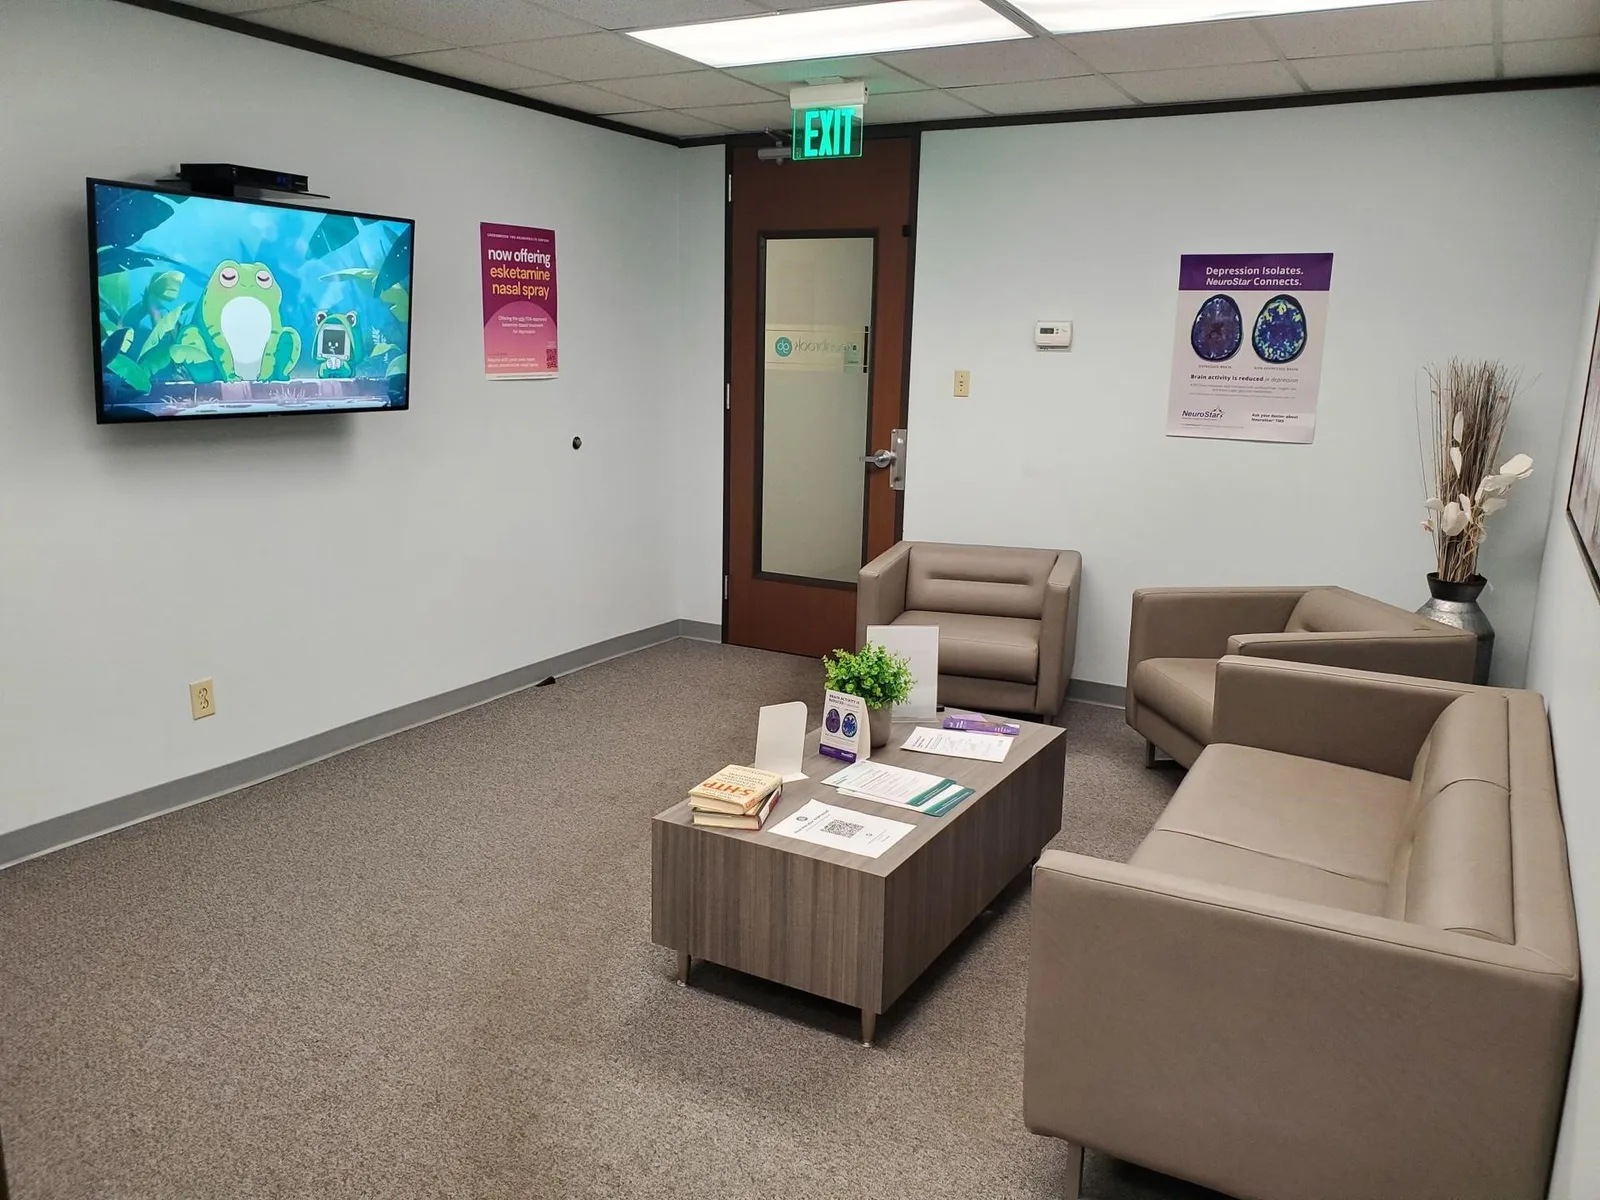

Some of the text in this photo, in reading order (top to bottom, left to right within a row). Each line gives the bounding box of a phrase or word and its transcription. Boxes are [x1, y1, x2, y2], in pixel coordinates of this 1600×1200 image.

[804, 108, 856, 157] EXIT
[488, 247, 551, 268] now offering
[490, 263, 550, 281] esketamine
[1205, 266, 1304, 277] Depression Isolates.
[1205, 277, 1302, 286] NeuroStar Connects.
[492, 281, 550, 300] nasal spray
[1208, 374, 1231, 382] activity
[1181, 410, 1220, 418] NeuroStar
[703, 782, 754, 796] 5-HTP
